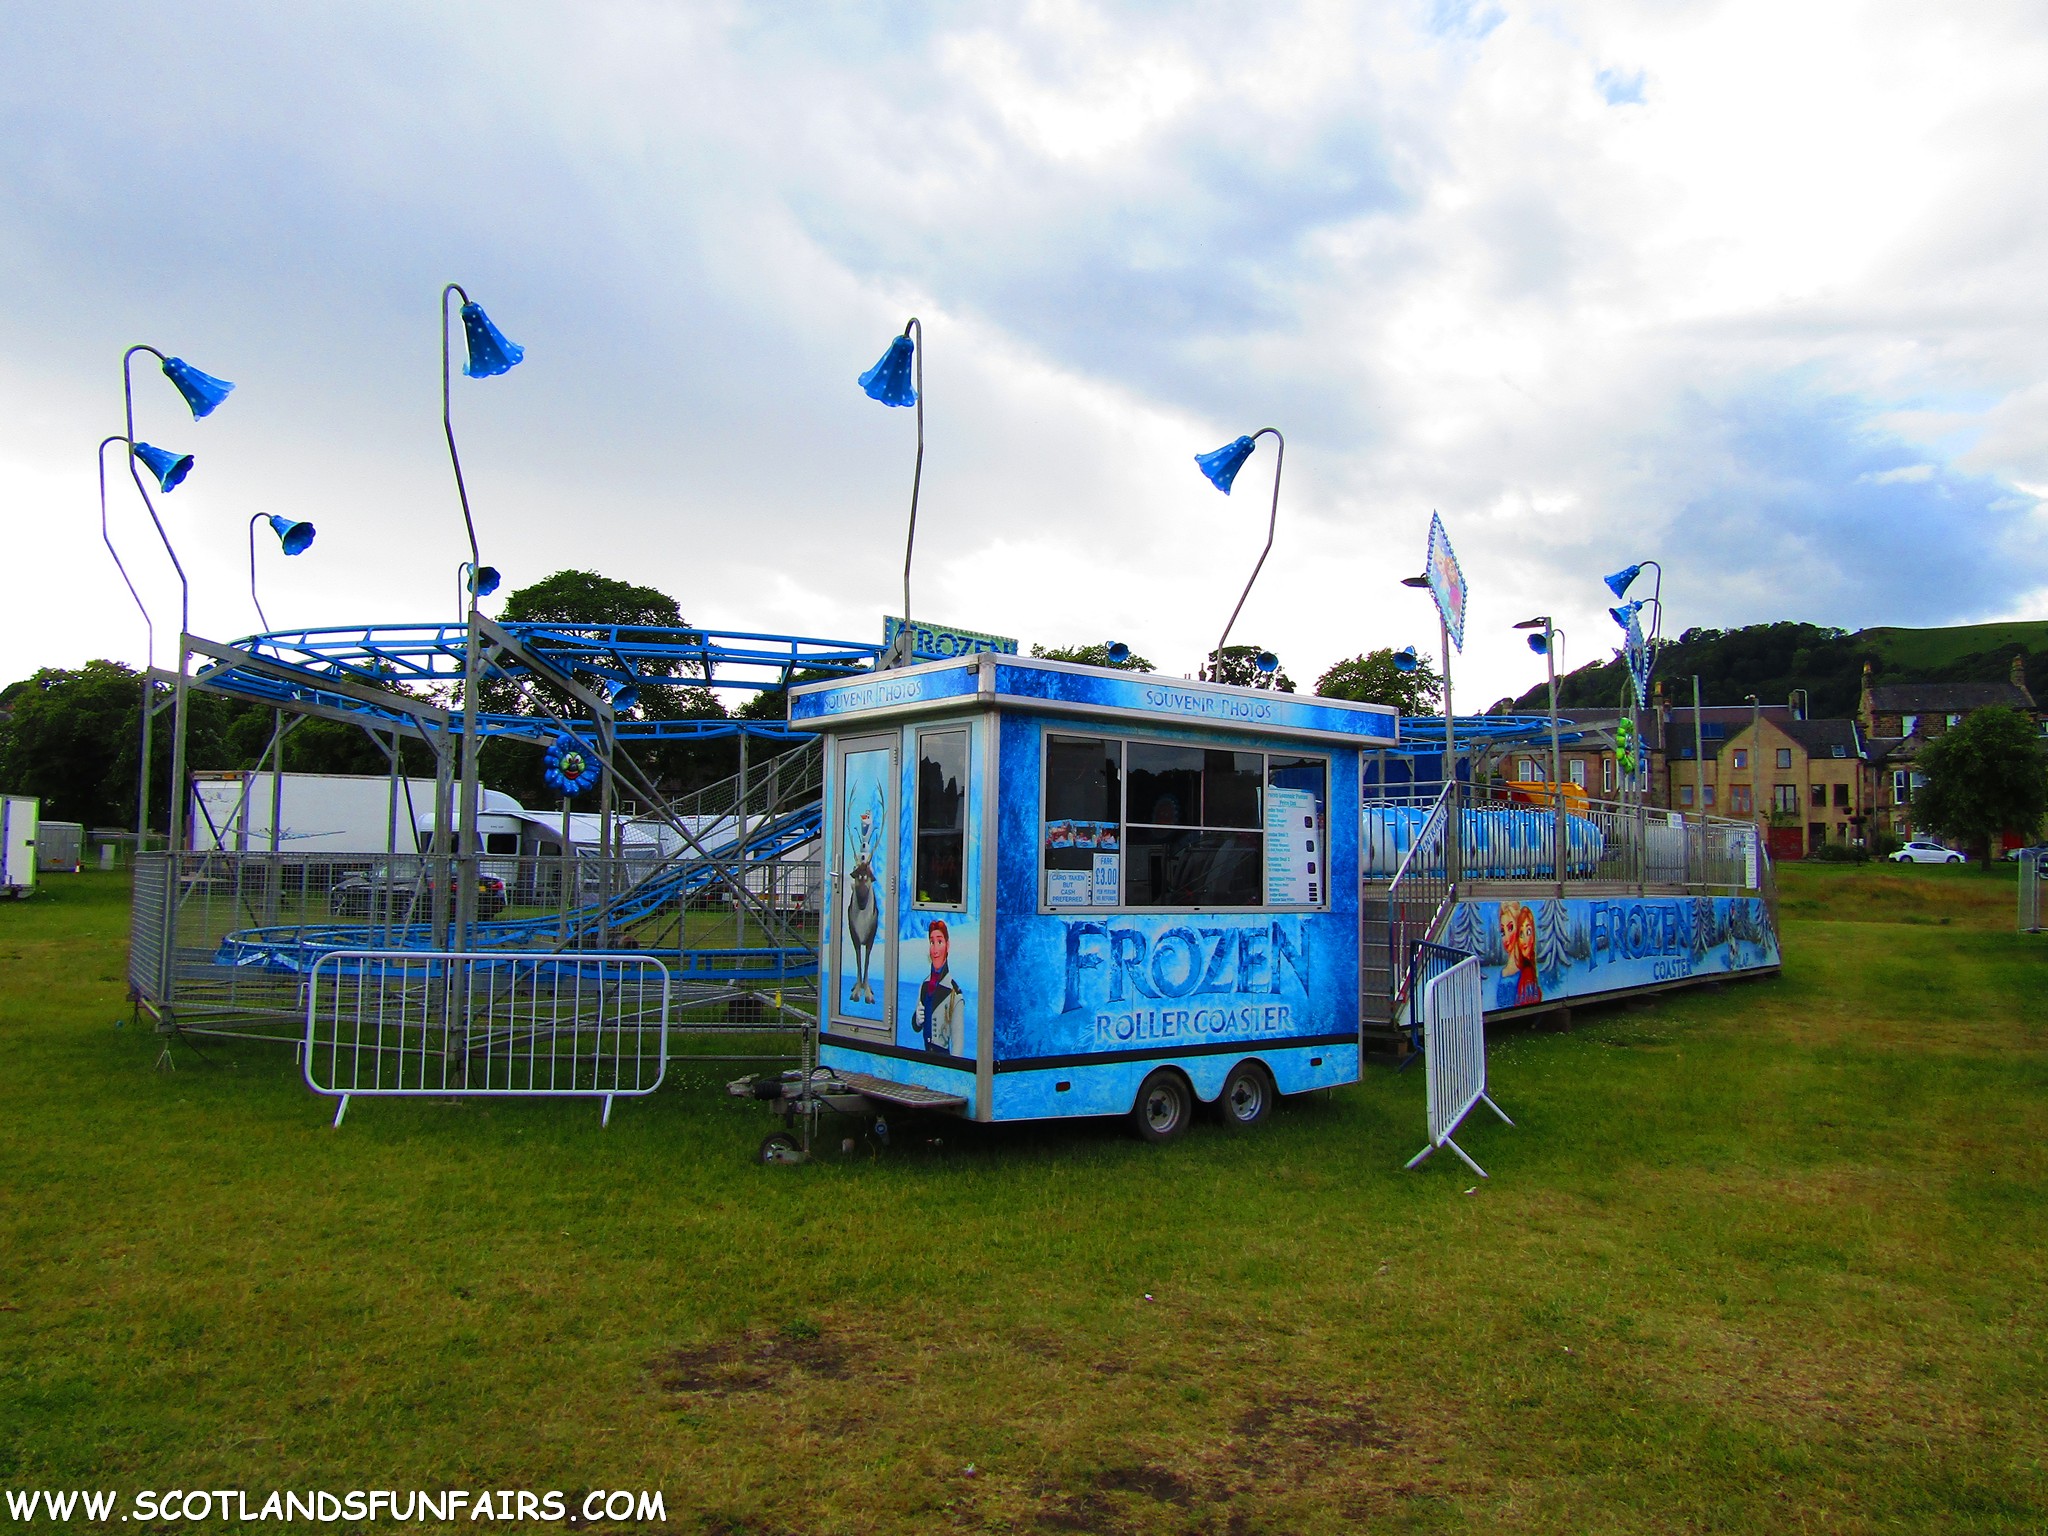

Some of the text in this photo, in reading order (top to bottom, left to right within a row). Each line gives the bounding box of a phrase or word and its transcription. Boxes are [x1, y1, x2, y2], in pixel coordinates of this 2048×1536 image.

[824, 681, 922, 709] SOUVENIR PHOTOS
[1146, 690, 1271, 718] SOUVENIR PHOTOS
[1101, 857, 1113, 865] FARE
[1095, 868, 1117, 885] £3.00
[1588, 900, 1693, 973] FROZEN
[1060, 918, 1312, 1014] FROZEN
[1653, 959, 1693, 981] COASTER
